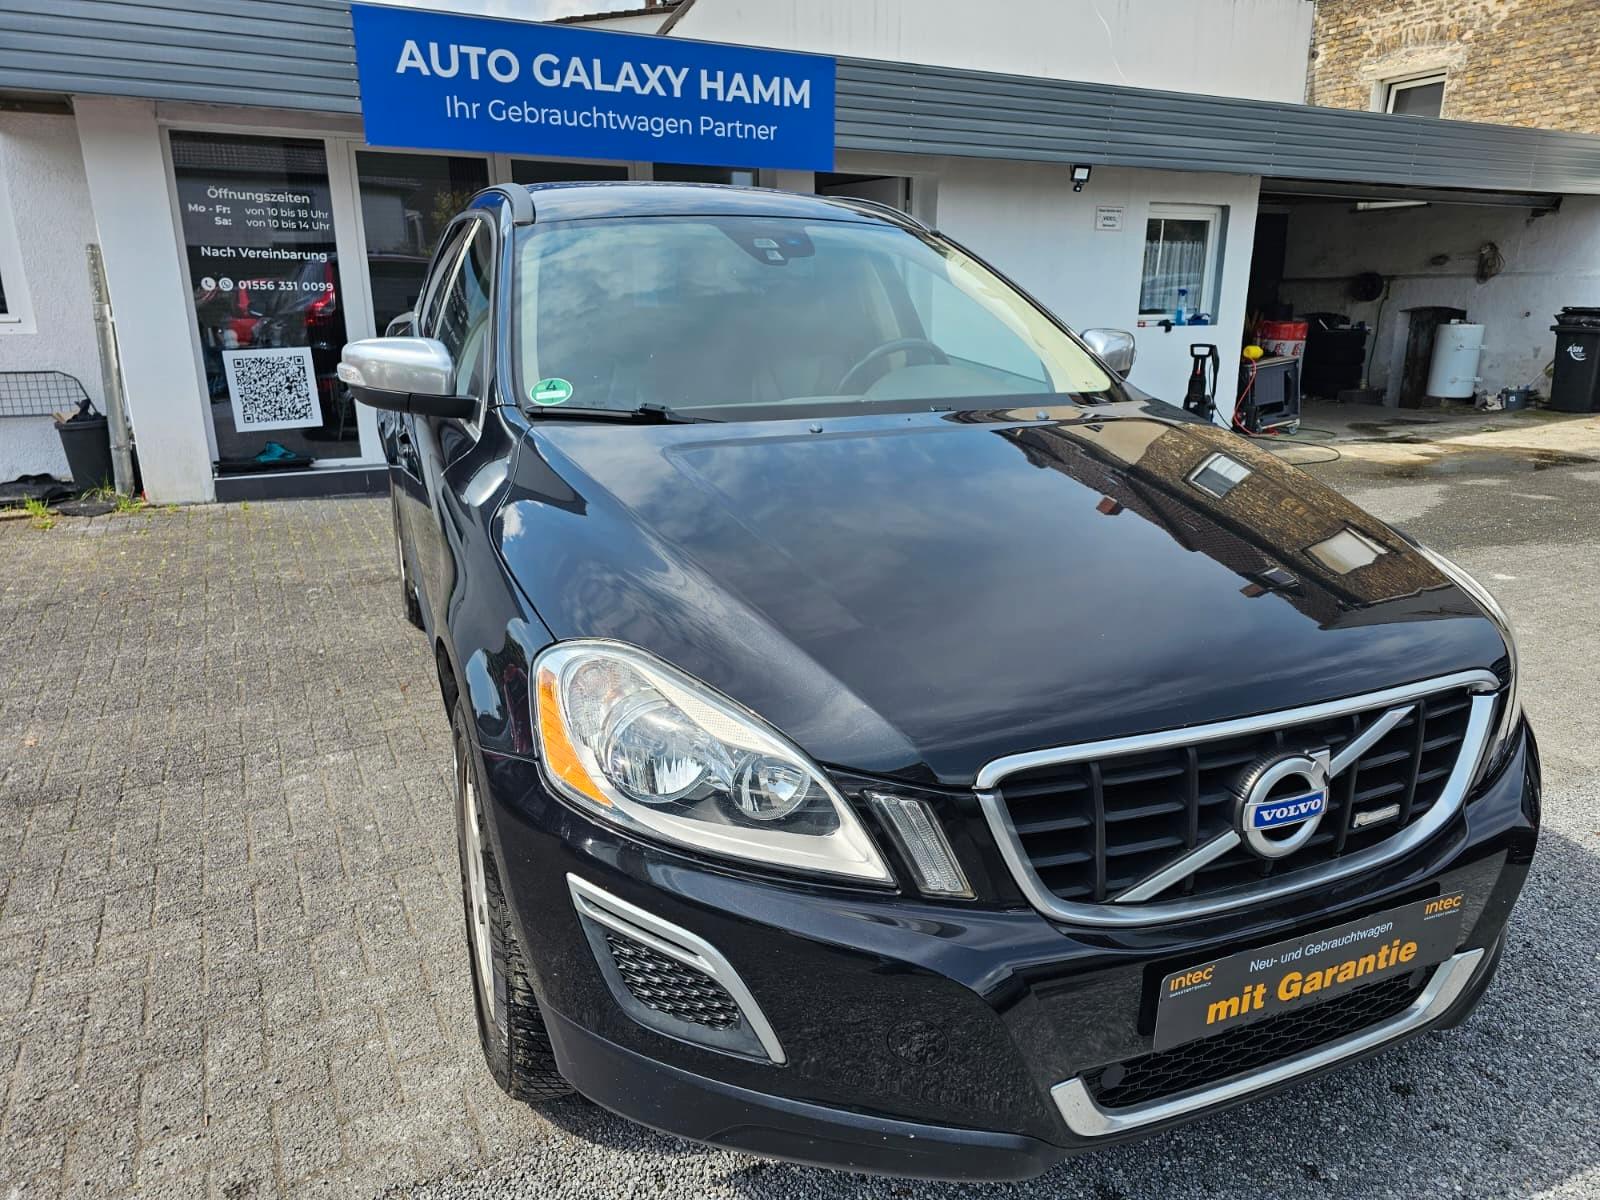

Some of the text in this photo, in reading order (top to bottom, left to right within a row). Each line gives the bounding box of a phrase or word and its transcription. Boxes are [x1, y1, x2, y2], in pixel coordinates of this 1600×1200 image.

[396, 39, 812, 109] AUTO GALAXY HAMM
[445, 95, 778, 141] Ihr Gebrauchtwagen Partner
[207, 186, 310, 204] Öffnungszeiten
[188, 203, 206, 213] Mo
[216, 206, 231, 214] Fr:
[245, 208, 265, 216] von
[267, 208, 278, 217] 10
[281, 209, 296, 218] bis
[298, 209, 308, 218] 18
[310, 210, 329, 219] Uhr
[215, 217, 232, 226] Sa:
[268, 219, 279, 229] 10
[282, 221, 297, 230] bis
[299, 221, 309, 230] 14
[312, 222, 331, 231] Uhr
[200, 246, 328, 263] Nach Vereinbarung
[238, 280, 334, 292] 01556 331 0099
[546, 380, 557, 391] 4
[1259, 798, 1322, 822] VOLVO
[1424, 893, 1463, 916] intec
[1249, 920, 1393, 974] Neu- und Gebrauchtwagen
[1170, 966, 1214, 992] intec
[1206, 938, 1418, 1025] mit Garantie
